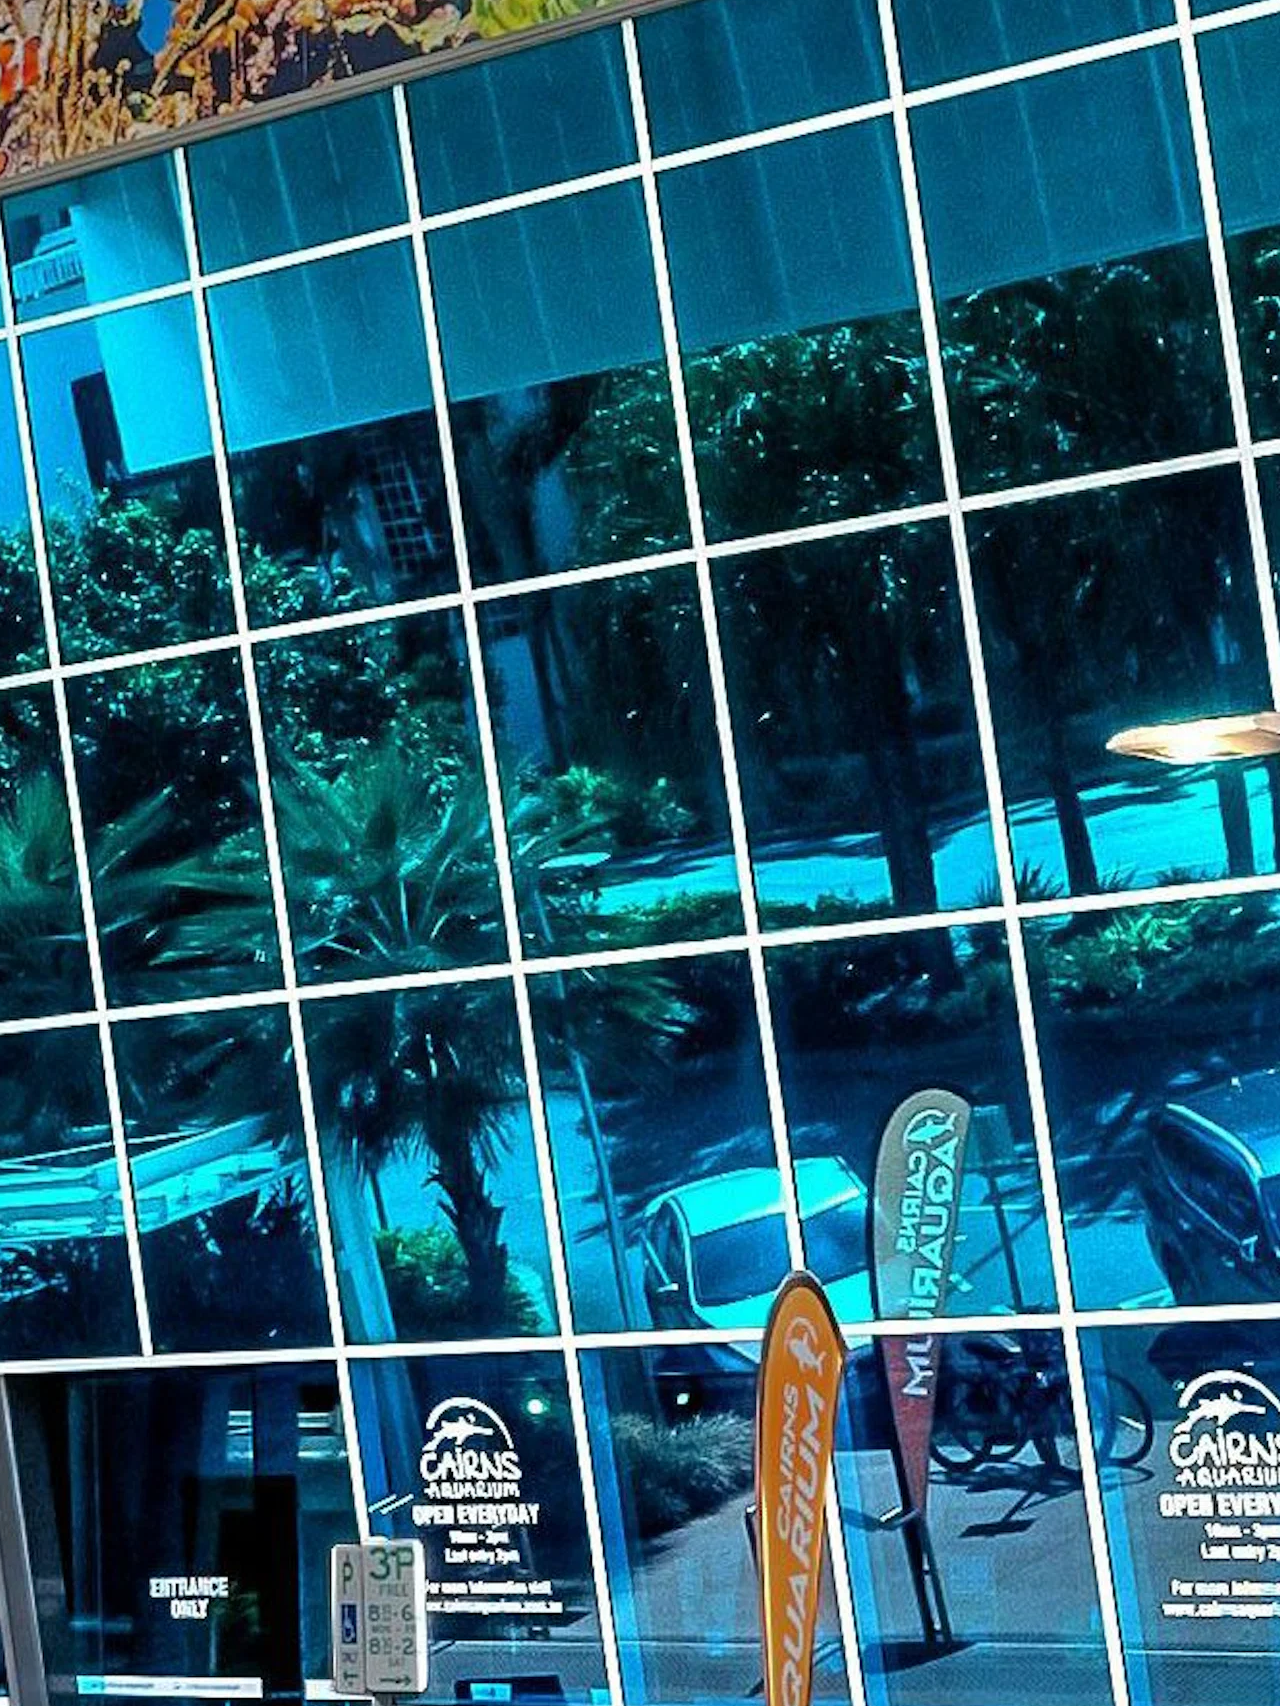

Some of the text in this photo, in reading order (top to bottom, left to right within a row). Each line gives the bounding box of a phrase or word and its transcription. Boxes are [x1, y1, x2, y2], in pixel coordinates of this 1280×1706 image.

[776, 1383, 799, 1538] CAIRNS
[1176, 1467, 1280, 1488] AQUARIU
[424, 1480, 521, 1499] AQUARIUM
[412, 1503, 540, 1526] OPEN EVERYDAY
[1159, 1493, 1280, 1517] OPEN EVERY
[369, 1546, 415, 1580] 3P
[149, 1577, 229, 1598] ENTRANCE
[170, 1599, 209, 1620] ONLY
